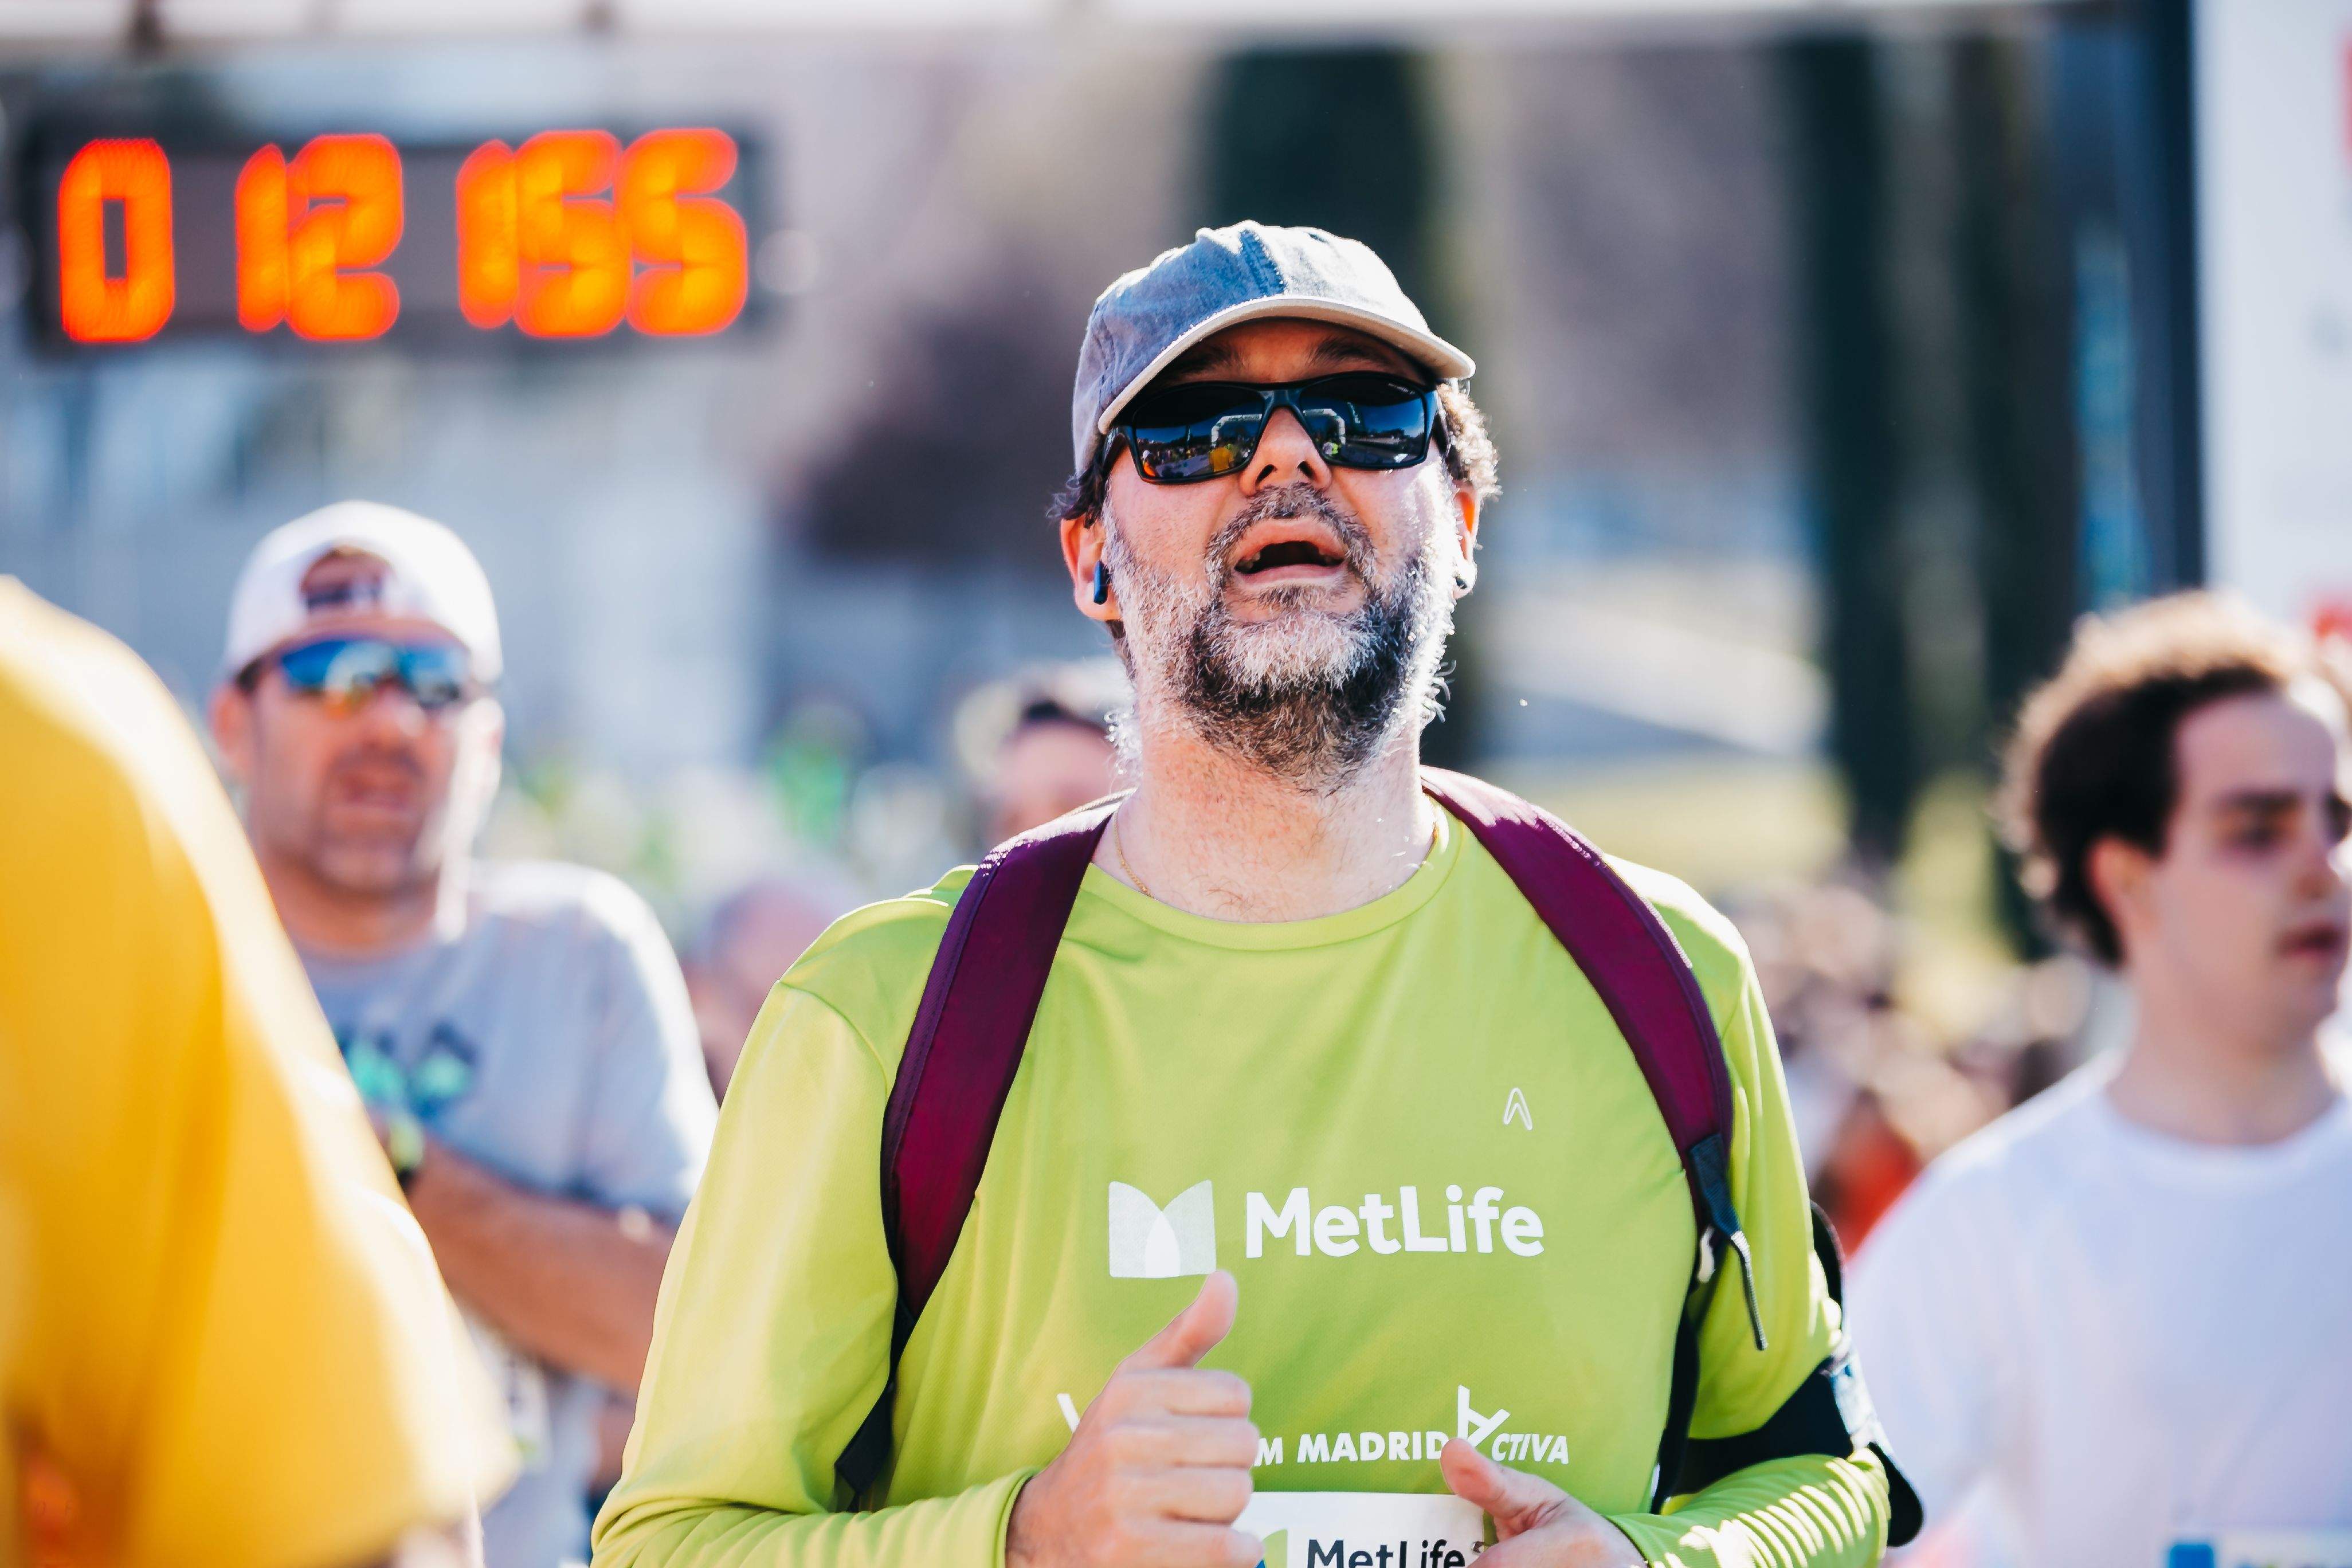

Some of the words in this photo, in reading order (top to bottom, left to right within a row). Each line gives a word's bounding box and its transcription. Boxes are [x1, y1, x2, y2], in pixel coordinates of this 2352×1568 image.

[58, 139, 174, 342] 0
[1245, 1183, 1545, 1259] MetLife
[1296, 1430, 1450, 1464] MADRID
[1307, 1538, 1466, 1568] MetLife
